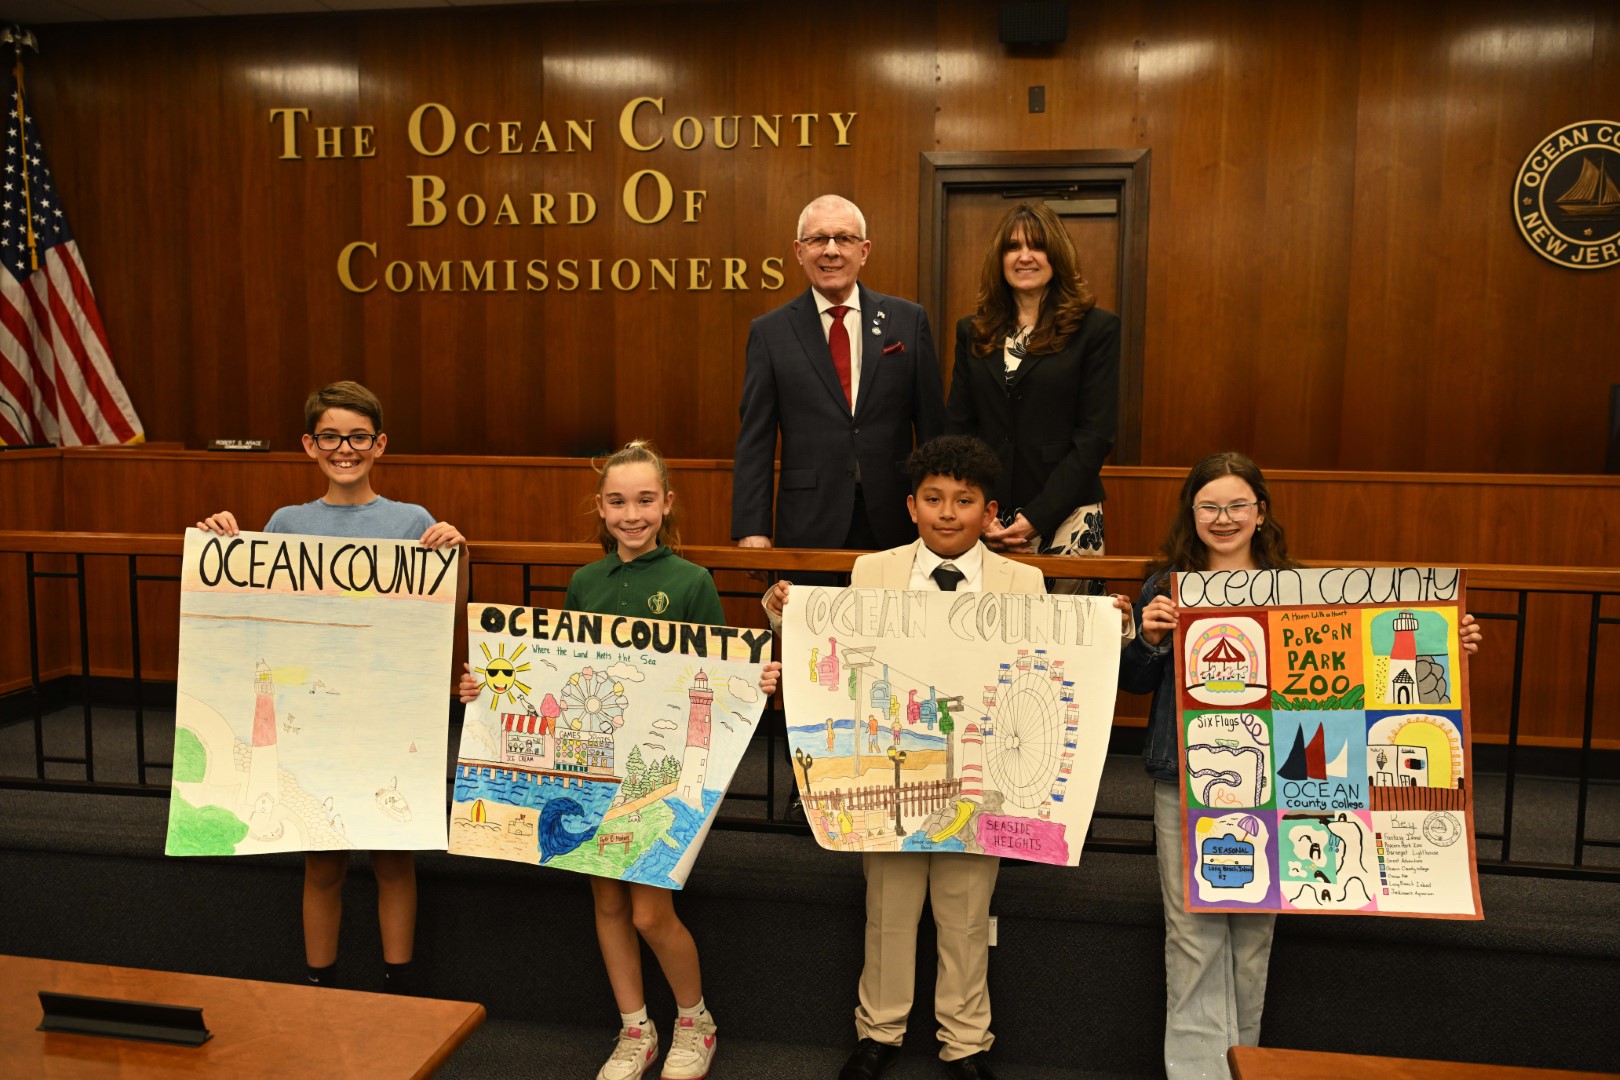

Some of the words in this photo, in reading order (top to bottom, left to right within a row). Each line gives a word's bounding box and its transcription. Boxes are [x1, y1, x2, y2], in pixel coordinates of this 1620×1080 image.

[1523, 127, 1589, 188] OCEAN
[1523, 211, 1568, 257] NEW
[1571, 239, 1620, 263] JER
[337, 241, 786, 293] COMMISSIONERS
[199, 537, 323, 591] OCEAN
[330, 544, 457, 596] COUNTY
[1180, 568, 1303, 607] ocean
[1319, 567, 1459, 605] county
[805, 587, 928, 638] OCEAN
[948, 591, 1097, 647] COUNTY
[1280, 613, 1290, 621] A
[480, 606, 603, 645] OCEAN
[611, 616, 772, 664] COUNTY
[531, 643, 551, 654] Where
[556, 646, 567, 656] the
[573, 649, 588, 659] Land
[618, 652, 631, 662] the
[640, 654, 656, 665] Sea
[1288, 650, 1346, 671] PARK
[1281, 673, 1350, 696] ZOO
[1197, 715, 1213, 728] Six
[1214, 714, 1240, 732] Flags
[560, 730, 581, 739] GAMES
[1283, 781, 1359, 800] OCEAN
[986, 820, 1032, 836] SEASIDE
[1390, 814, 1415, 836] Key
[994, 835, 1042, 851] HEIGHTS
[1212, 845, 1249, 853] SEASONAL
